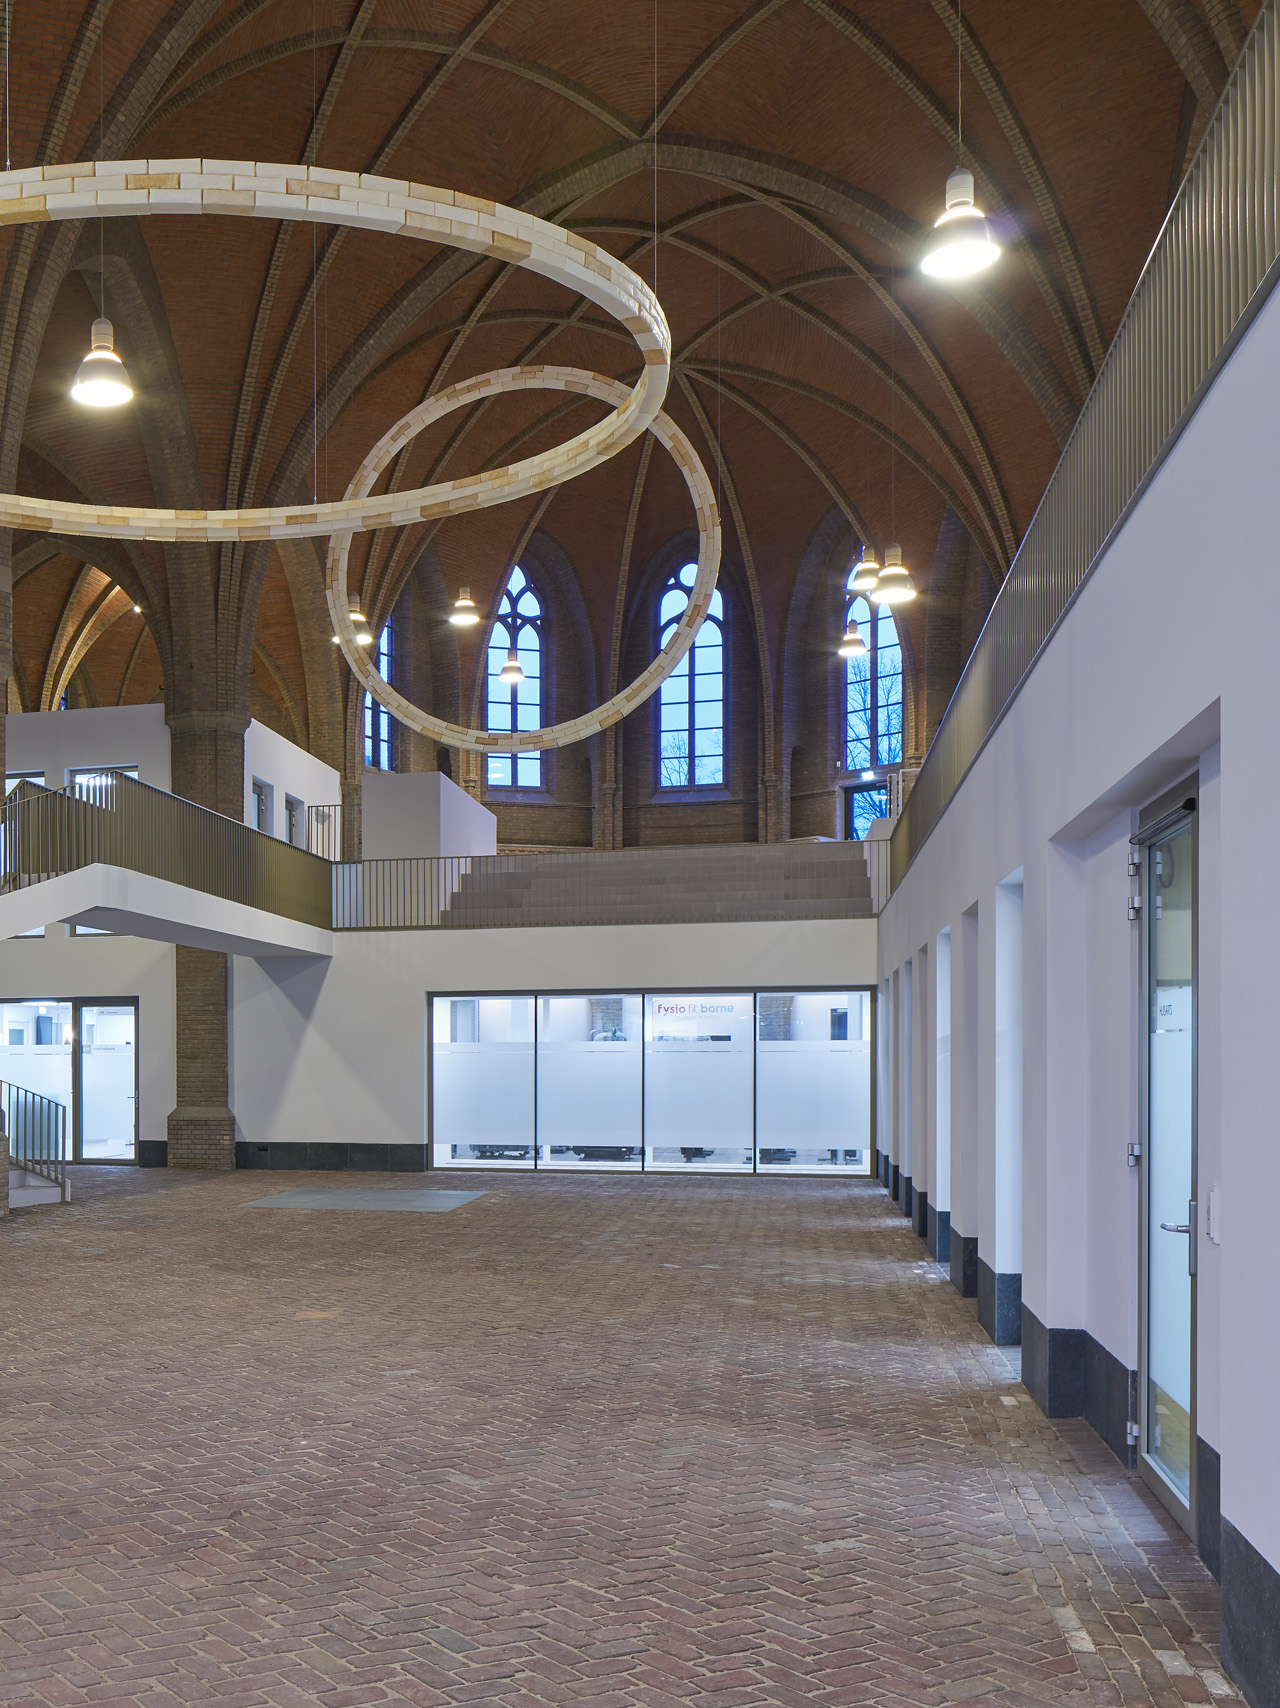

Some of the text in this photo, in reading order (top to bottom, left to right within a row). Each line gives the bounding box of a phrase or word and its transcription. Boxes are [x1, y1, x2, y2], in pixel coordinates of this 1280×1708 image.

[657, 1003, 734, 1016] fysio fit borne
